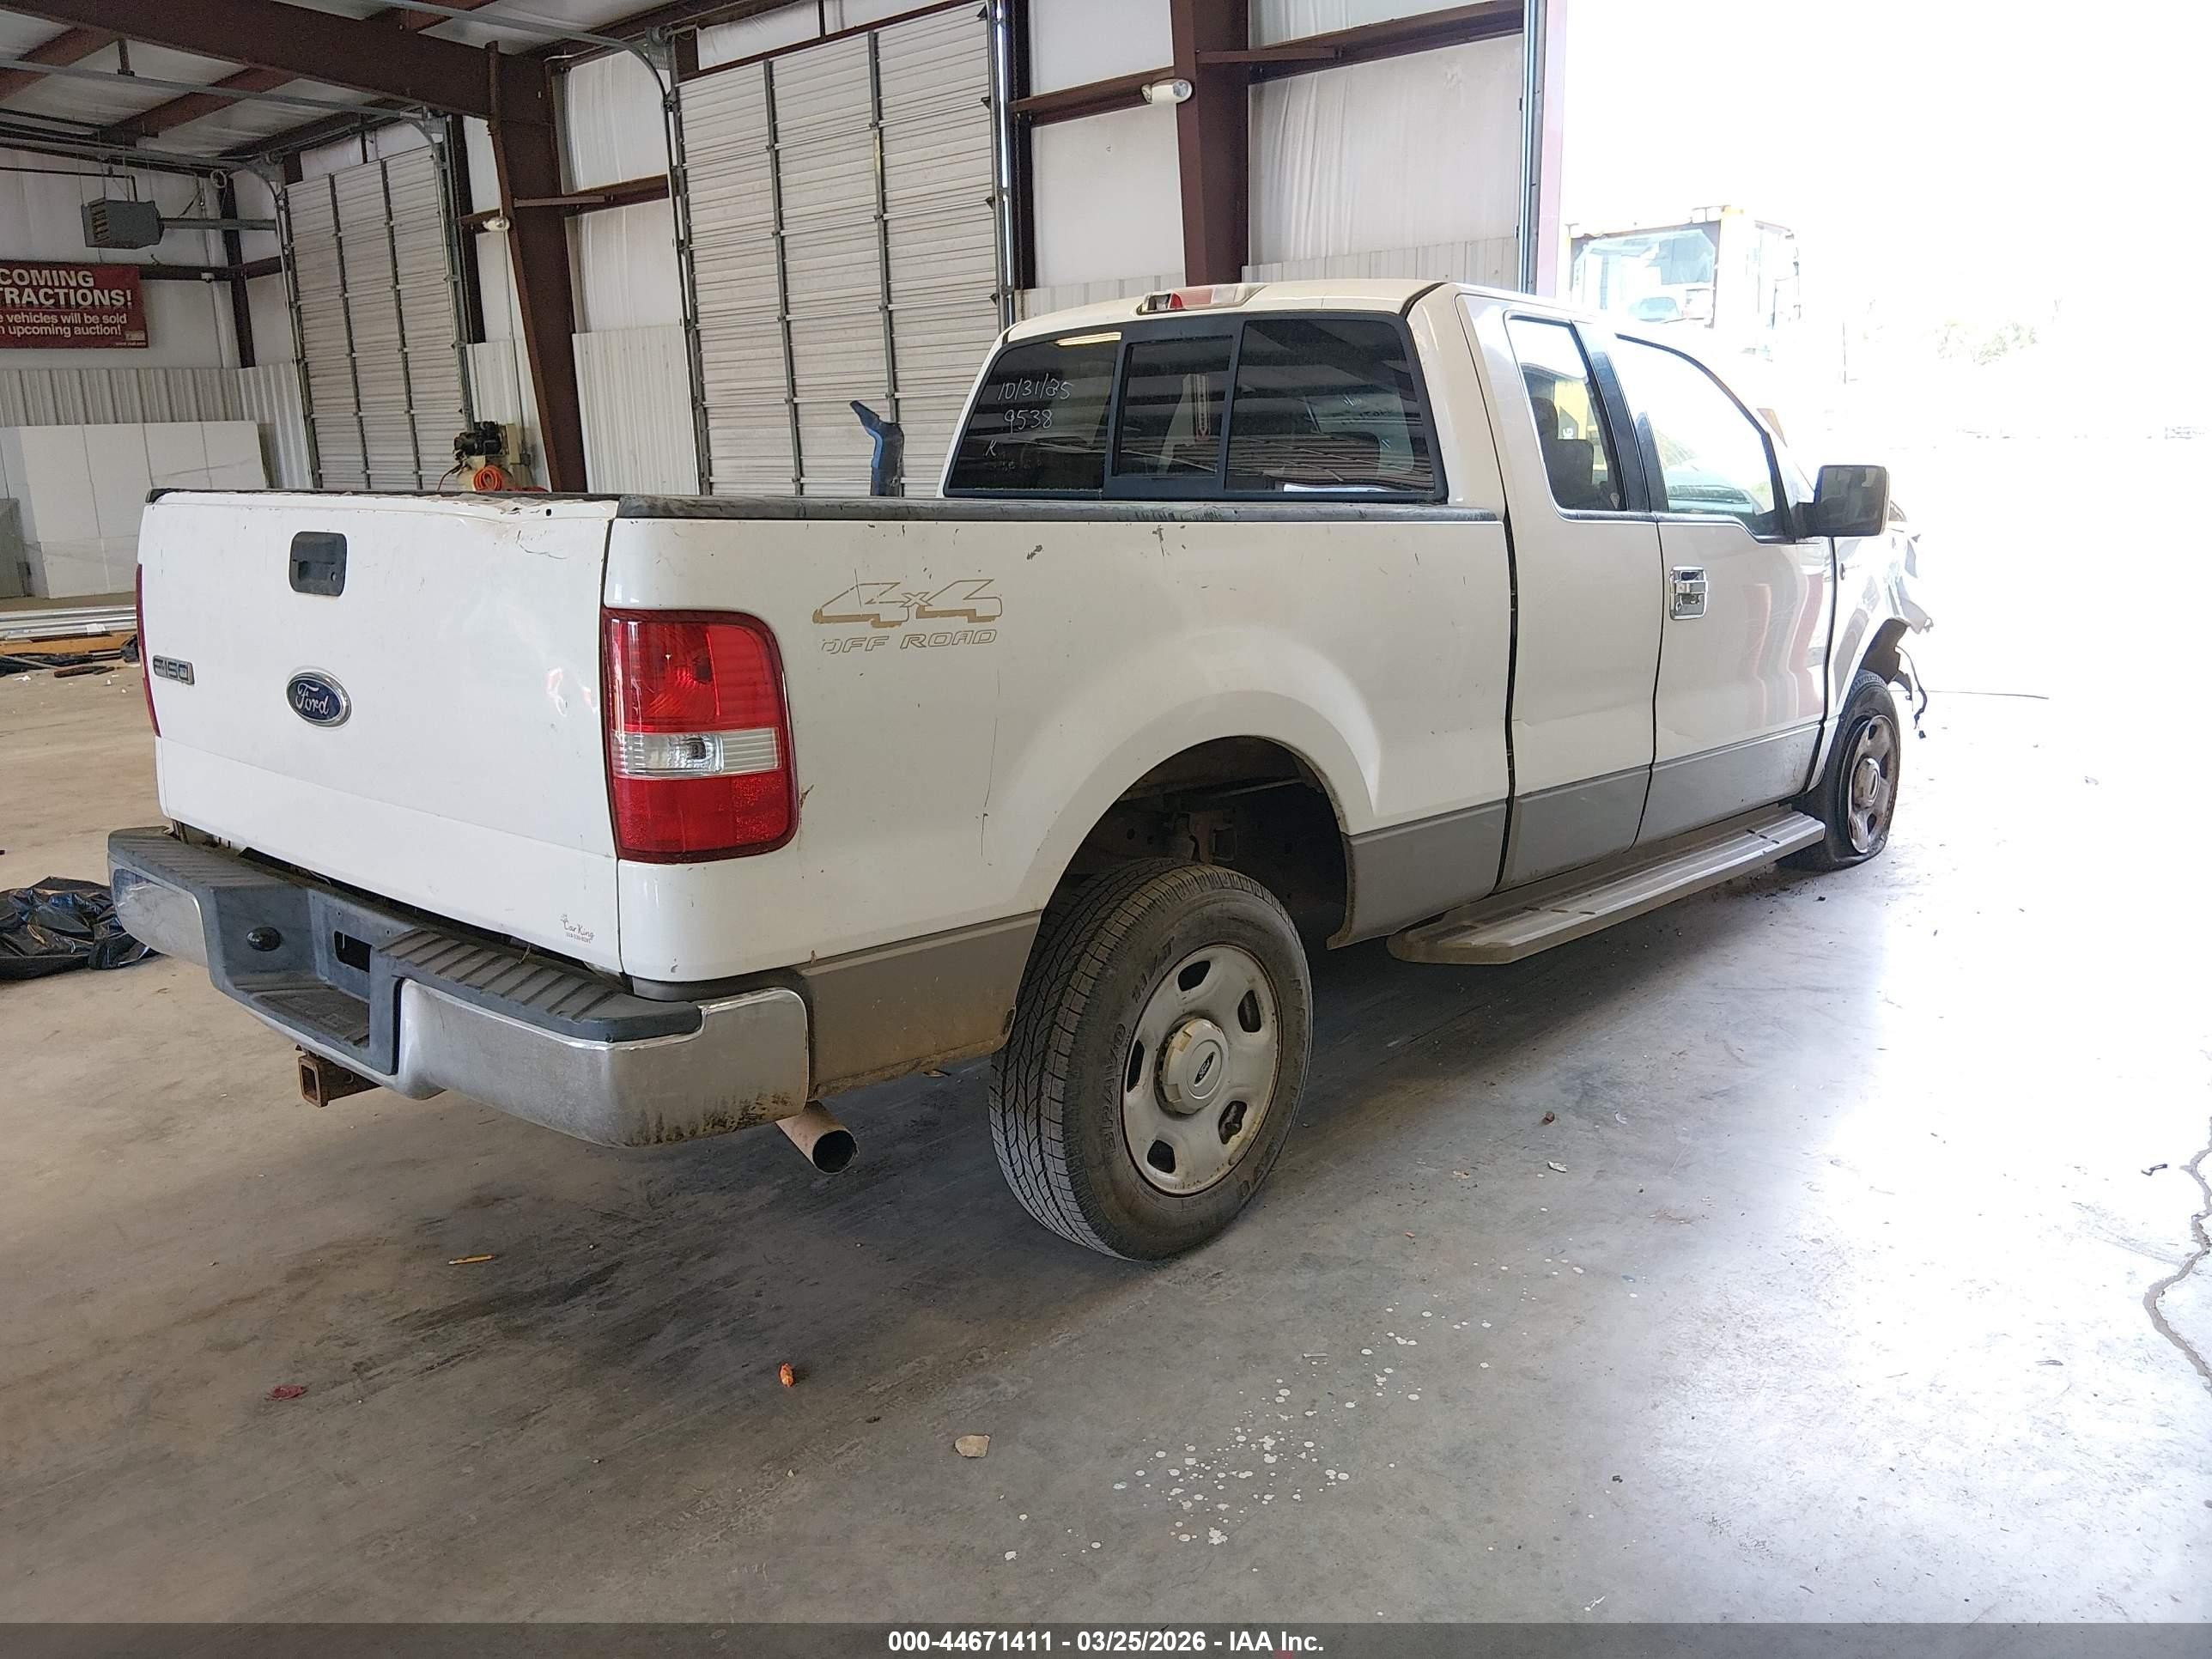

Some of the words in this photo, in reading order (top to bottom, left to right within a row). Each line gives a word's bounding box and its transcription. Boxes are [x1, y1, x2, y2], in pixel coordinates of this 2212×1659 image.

[0, 268, 94, 287] COMING
[0, 287, 132, 306] RACTIONS!
[5, 312, 58, 324] vehicles
[61, 313, 82, 323] will
[84, 313, 102, 324] be
[102, 313, 127, 324] sold
[9, 325, 71, 337] upcoming
[74, 325, 121, 336] auction!
[1004, 409, 1052, 434] 9538
[821, 635, 889, 654] OFF
[899, 629, 997, 649] ROAD
[295, 683, 330, 715] Ford
[563, 920, 577, 932] Car
[577, 923, 594, 941] King
